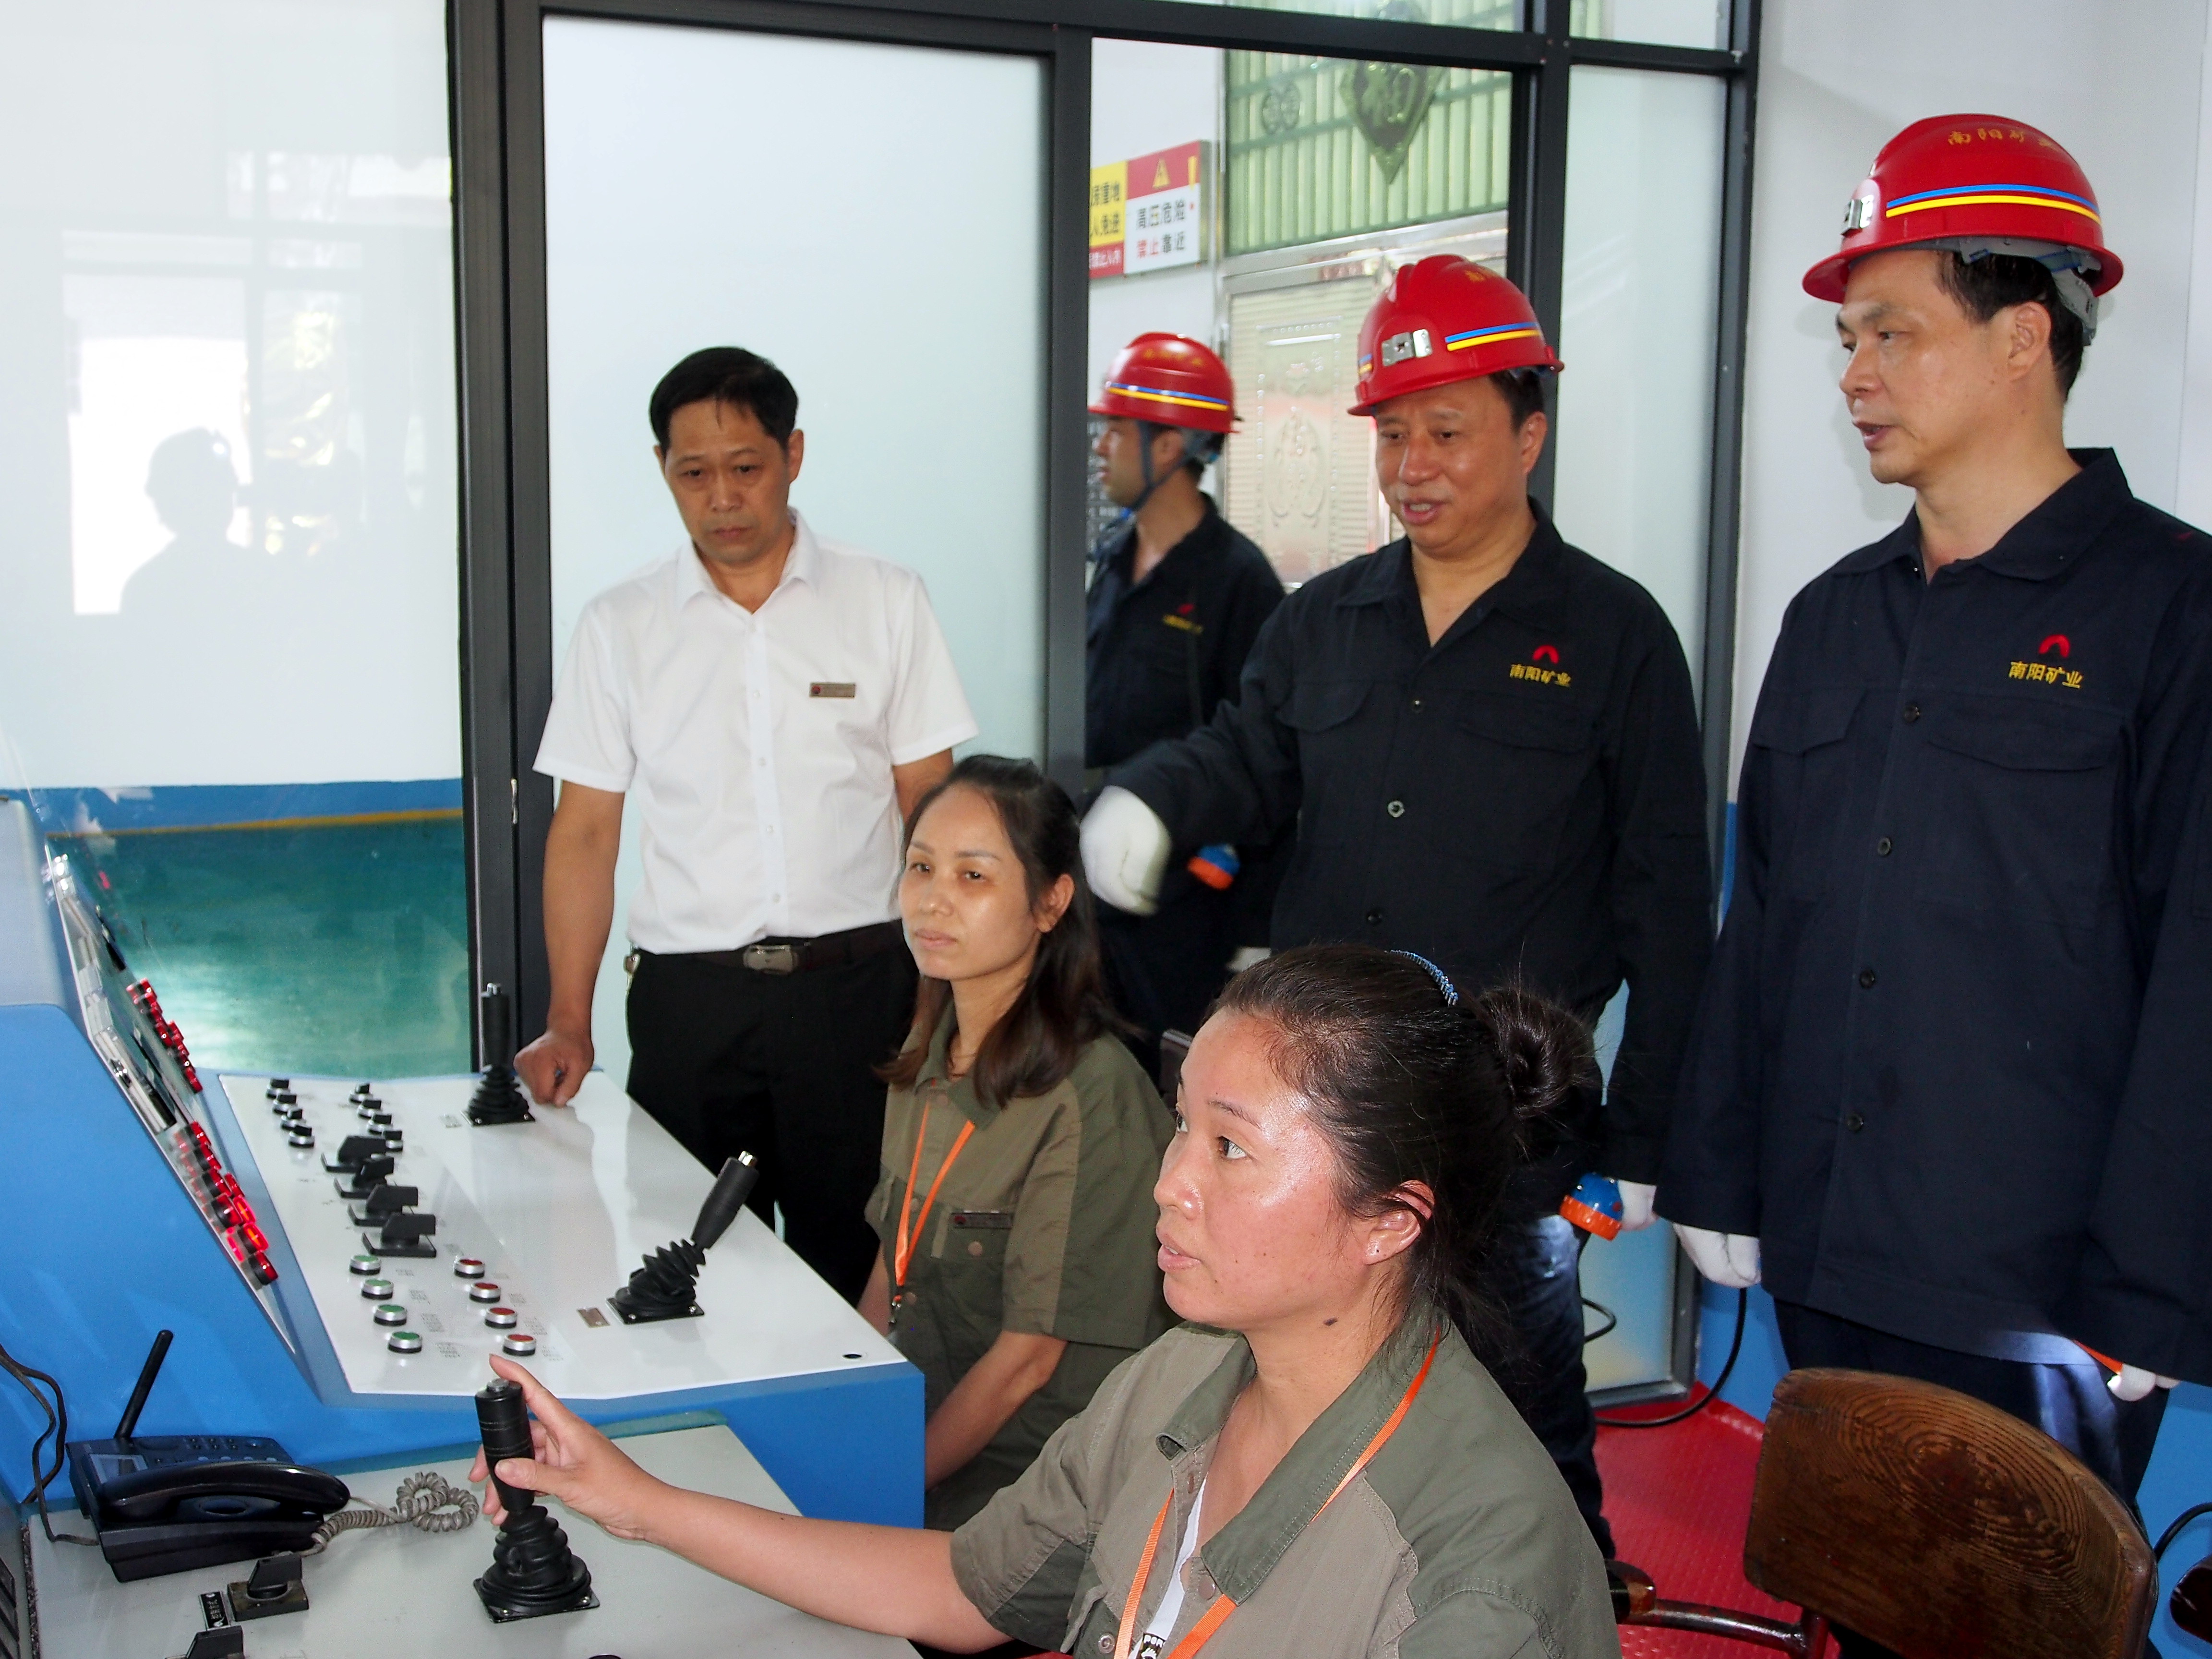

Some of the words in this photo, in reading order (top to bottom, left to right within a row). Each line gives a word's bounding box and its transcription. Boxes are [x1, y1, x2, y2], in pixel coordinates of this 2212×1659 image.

[1509, 664, 1571, 687] 南阳矿业
[2008, 661, 2083, 688] 南阳矿业
[1143, 1635, 1166, 1648] POR
